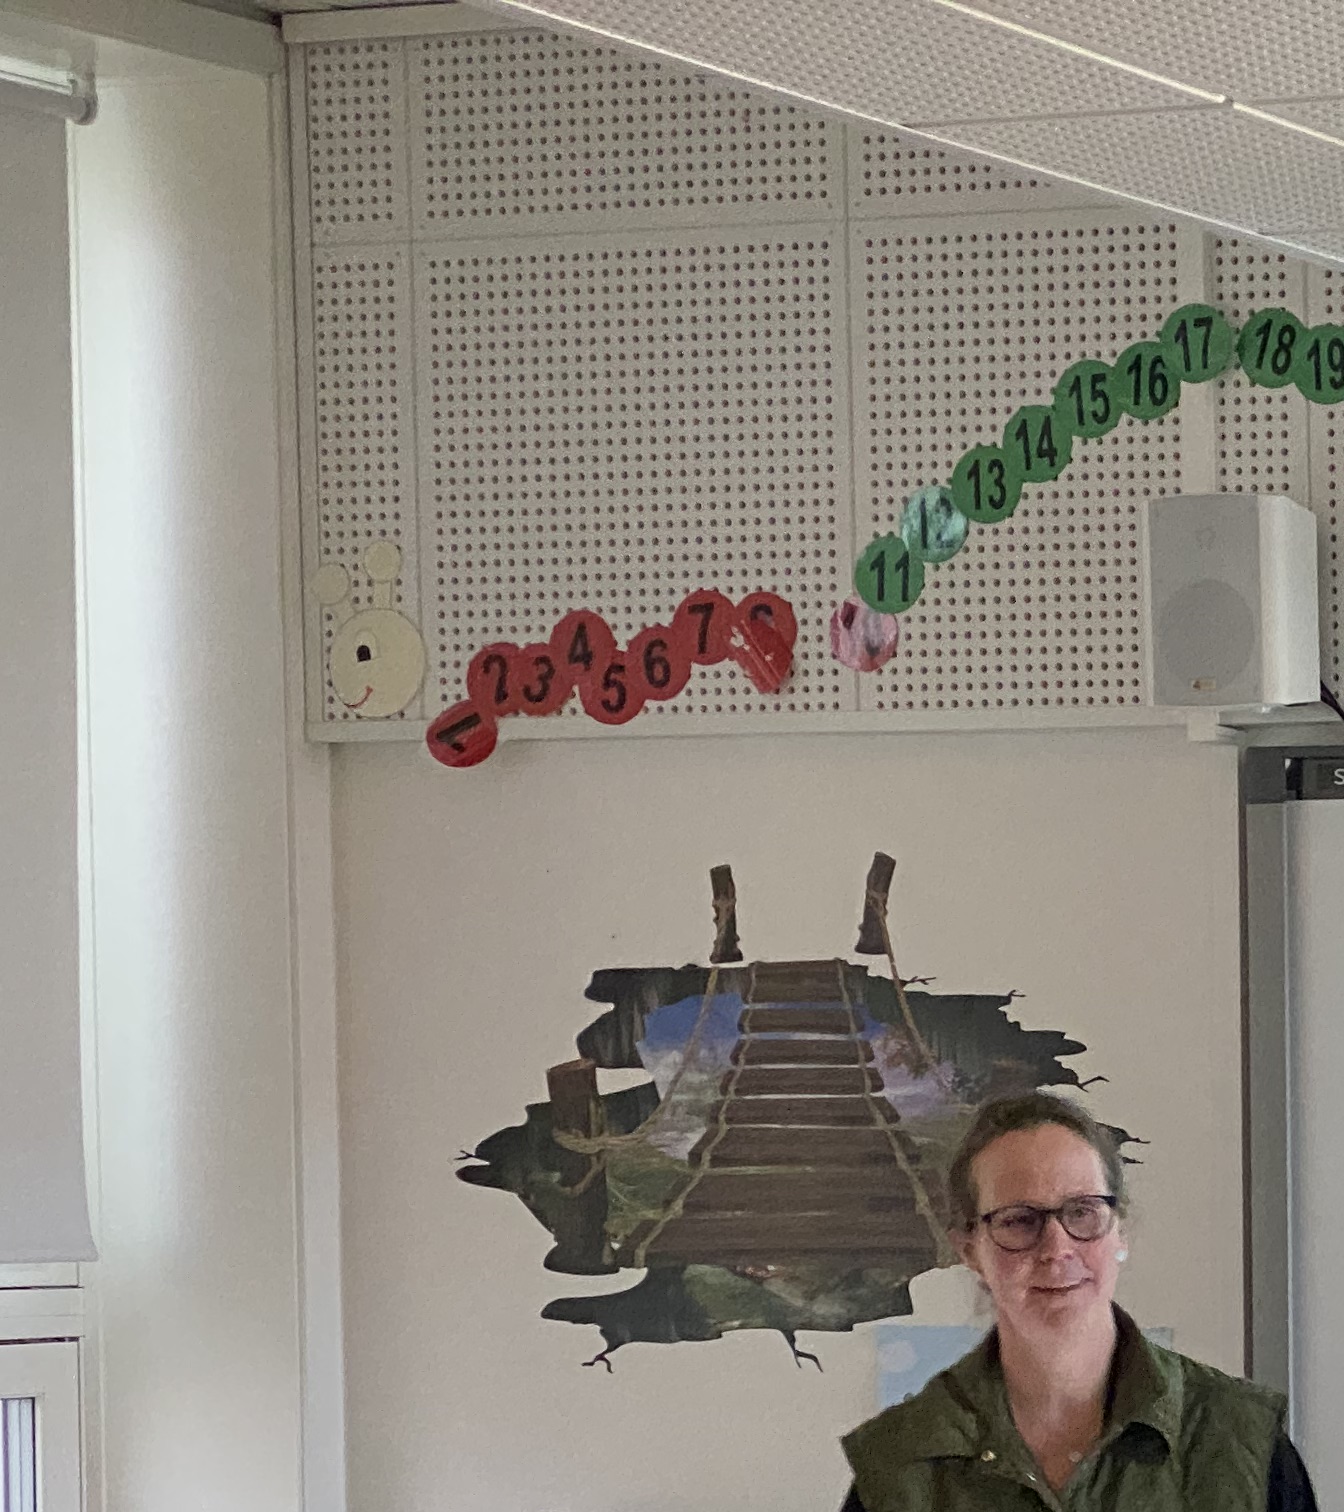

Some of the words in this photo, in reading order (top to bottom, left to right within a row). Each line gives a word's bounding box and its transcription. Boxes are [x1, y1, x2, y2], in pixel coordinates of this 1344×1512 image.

[868, 553, 909, 602] 11
[966, 459, 1007, 511] 13
[1014, 419, 1057, 468] 14
[1068, 374, 1110, 426] 15
[1126, 356, 1168, 407] 16
[1174, 317, 1213, 368] 17
[1254, 318, 1296, 375] 18
[435, 711, 482, 752] 1
[483, 654, 509, 701] 2
[522, 655, 555, 702] 3
[567, 622, 594, 671] 4
[601, 664, 627, 713] 5
[644, 640, 671, 687] 6
[687, 602, 715, 653] 7
